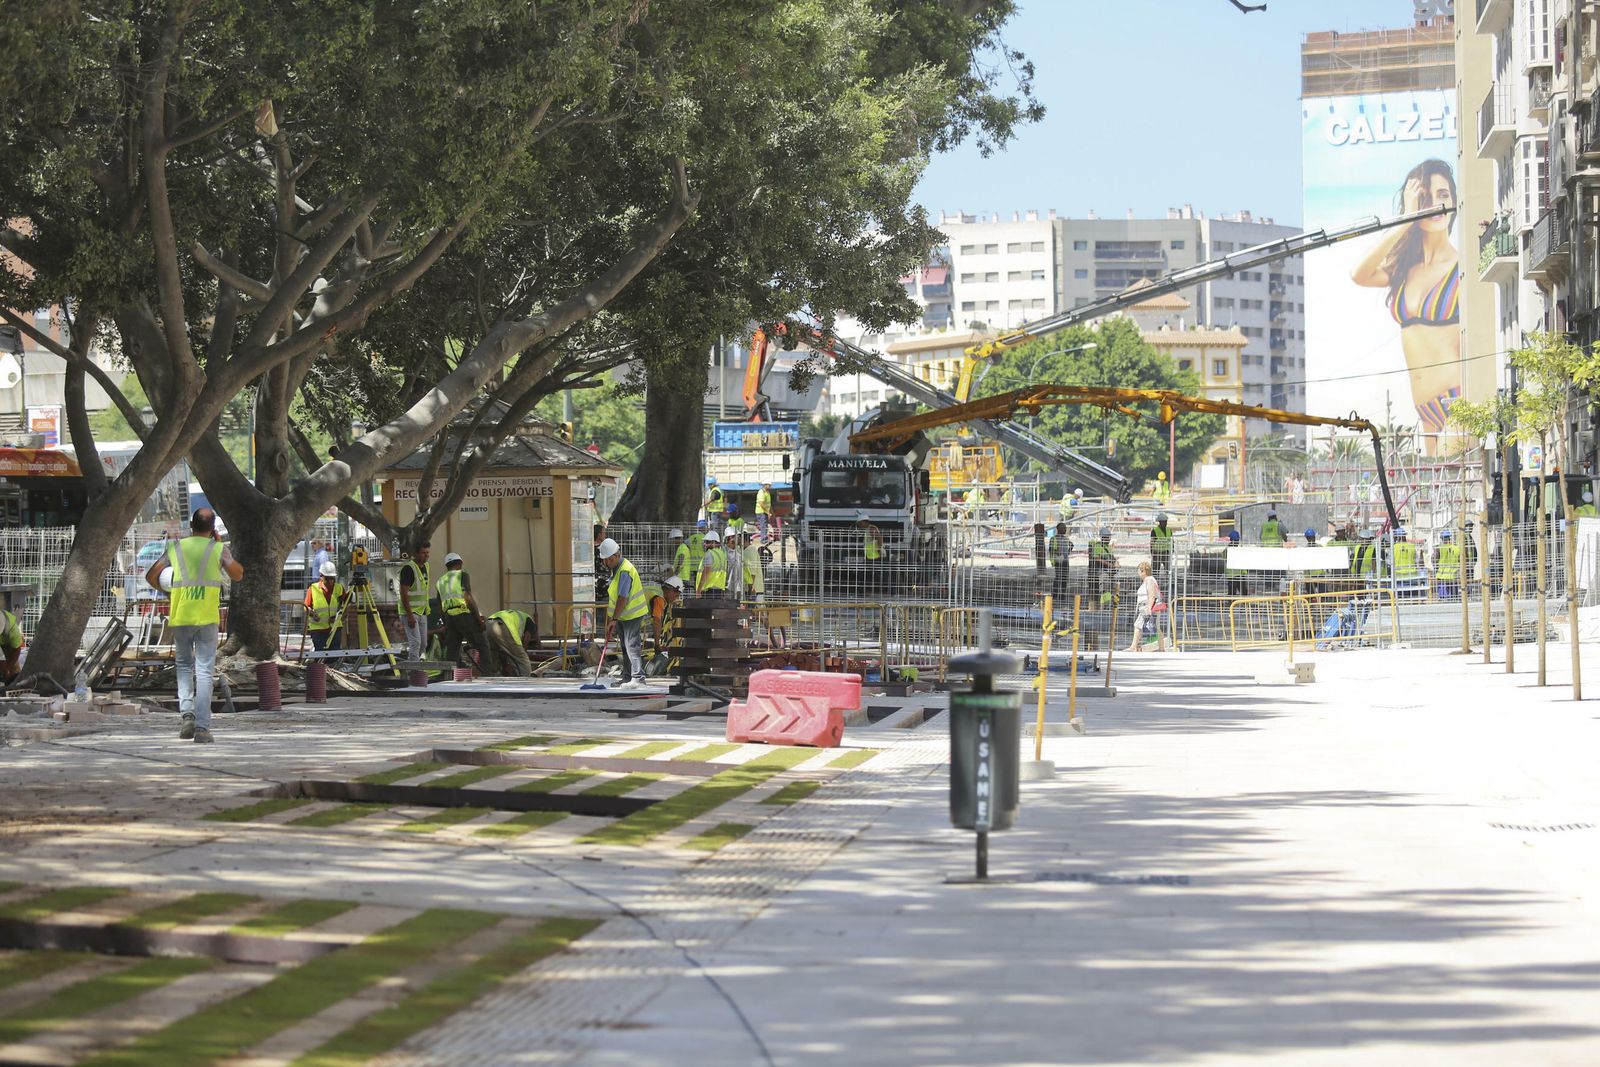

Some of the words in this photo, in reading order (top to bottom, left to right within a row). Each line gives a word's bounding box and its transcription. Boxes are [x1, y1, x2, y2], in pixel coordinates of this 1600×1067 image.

[827, 460, 888, 468] MANIVELA
[478, 479, 507, 487] PRENSA
[512, 478, 544, 486] BEBIDAS
[481, 485, 554, 498] BUS/MÓVILES
